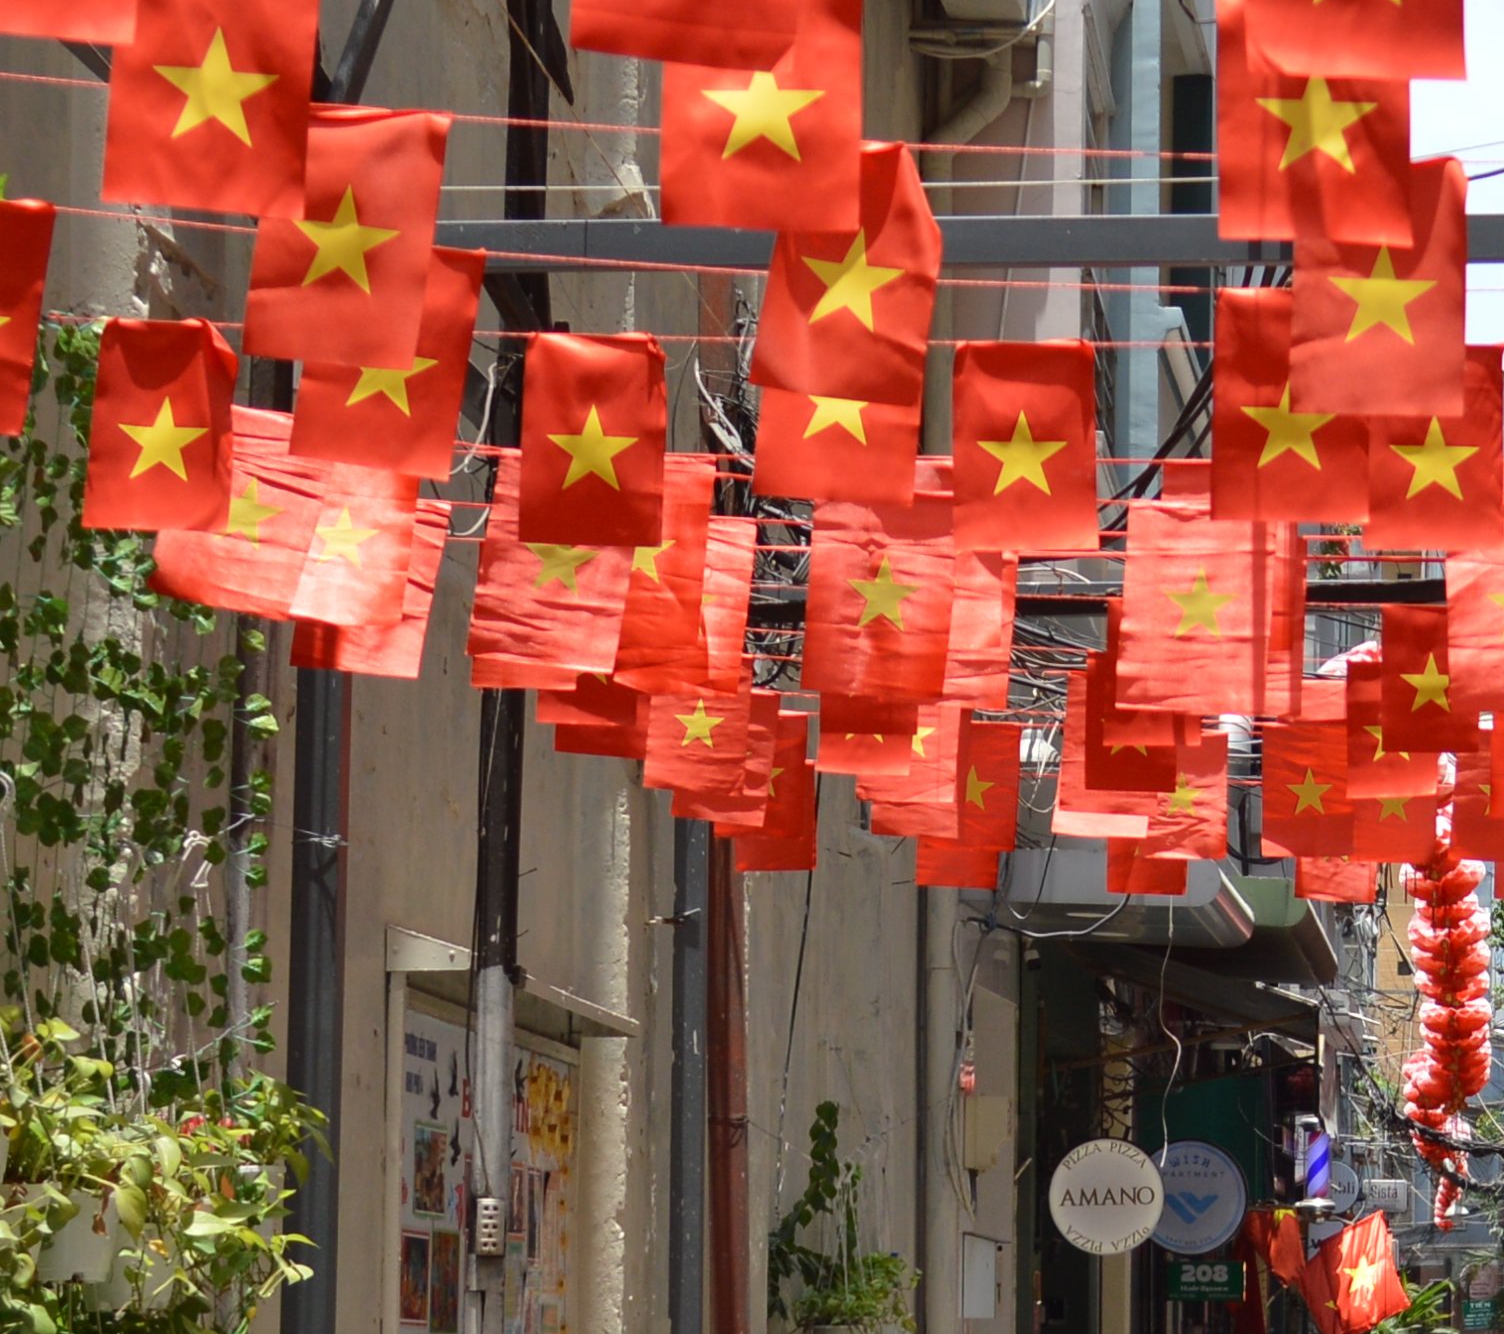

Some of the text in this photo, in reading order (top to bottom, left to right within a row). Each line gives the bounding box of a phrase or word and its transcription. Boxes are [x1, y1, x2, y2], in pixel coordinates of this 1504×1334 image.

[1062, 1142, 1147, 1170] PIZZA PIZZA
[1168, 1154, 1211, 1168] WISH
[1162, 1170, 1225, 1178] PARTMENT
[1060, 1186, 1155, 1207] AMANO
[1370, 1184, 1398, 1199] Sista
[1065, 1225, 1103, 1252] PIZZA
[1110, 1226, 1150, 1251] PIZZA
[1180, 1264, 1229, 1283] 208
